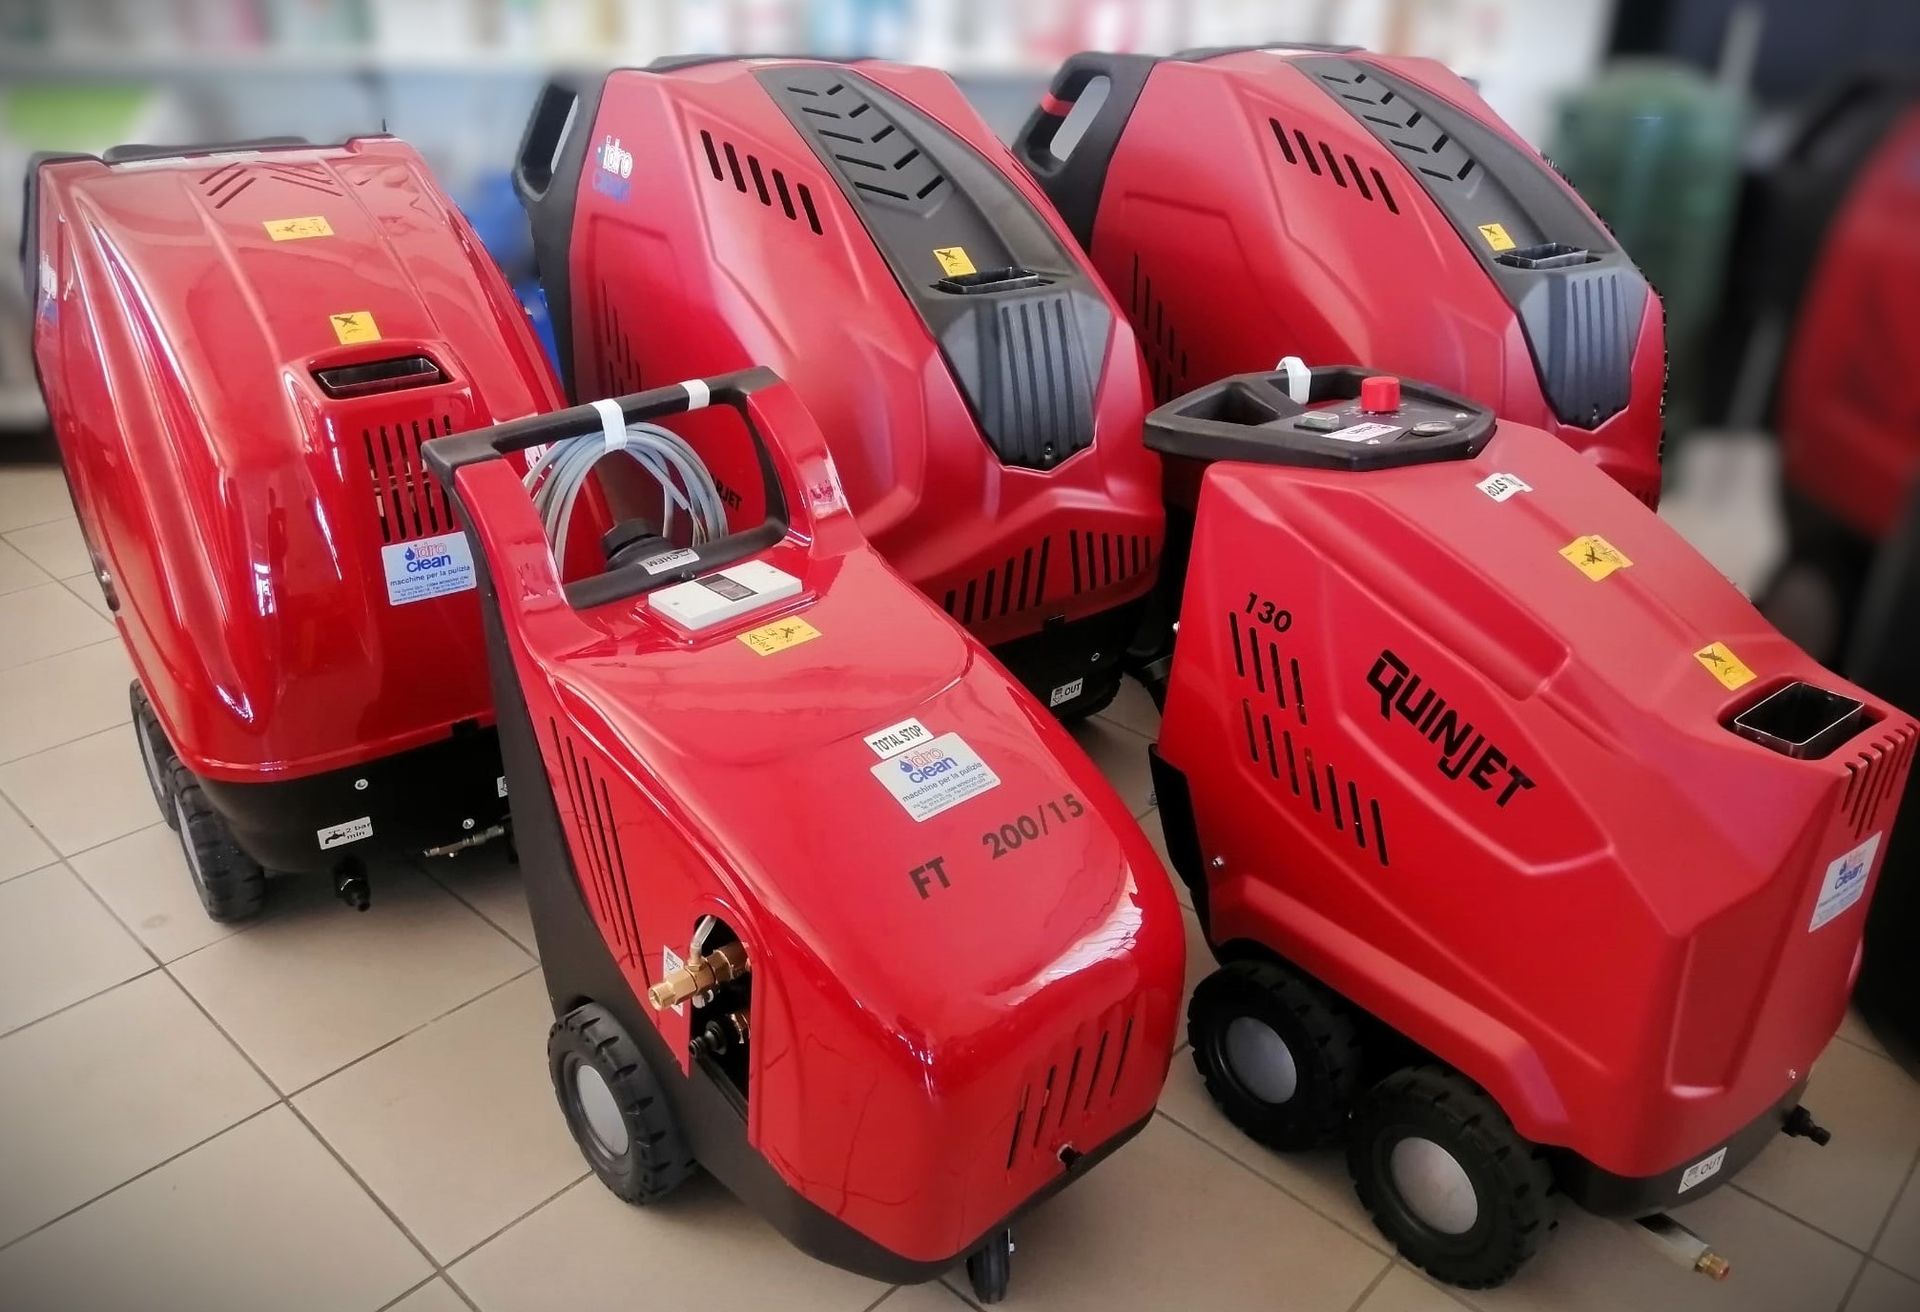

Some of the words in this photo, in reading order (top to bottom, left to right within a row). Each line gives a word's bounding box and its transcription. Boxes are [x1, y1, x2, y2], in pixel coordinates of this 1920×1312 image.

[390, 574, 425, 587] macchine
[426, 572, 438, 582] per
[448, 565, 470, 576] pulizia
[406, 554, 452, 573] clean
[1245, 592, 1293, 633] 130
[1064, 682, 1081, 696] OUT
[873, 733, 905, 752] TOTAL
[900, 725, 924, 742] STOP
[1366, 648, 1537, 808] QUINJET
[902, 783, 938, 802] macchine
[939, 776, 951, 787] per
[951, 772, 960, 780] la
[959, 762, 983, 778] pulizia
[909, 757, 958, 783] clean
[909, 856, 951, 900] FT
[982, 793, 1084, 860] 200/15
[1700, 1153, 1723, 1175] OUT
